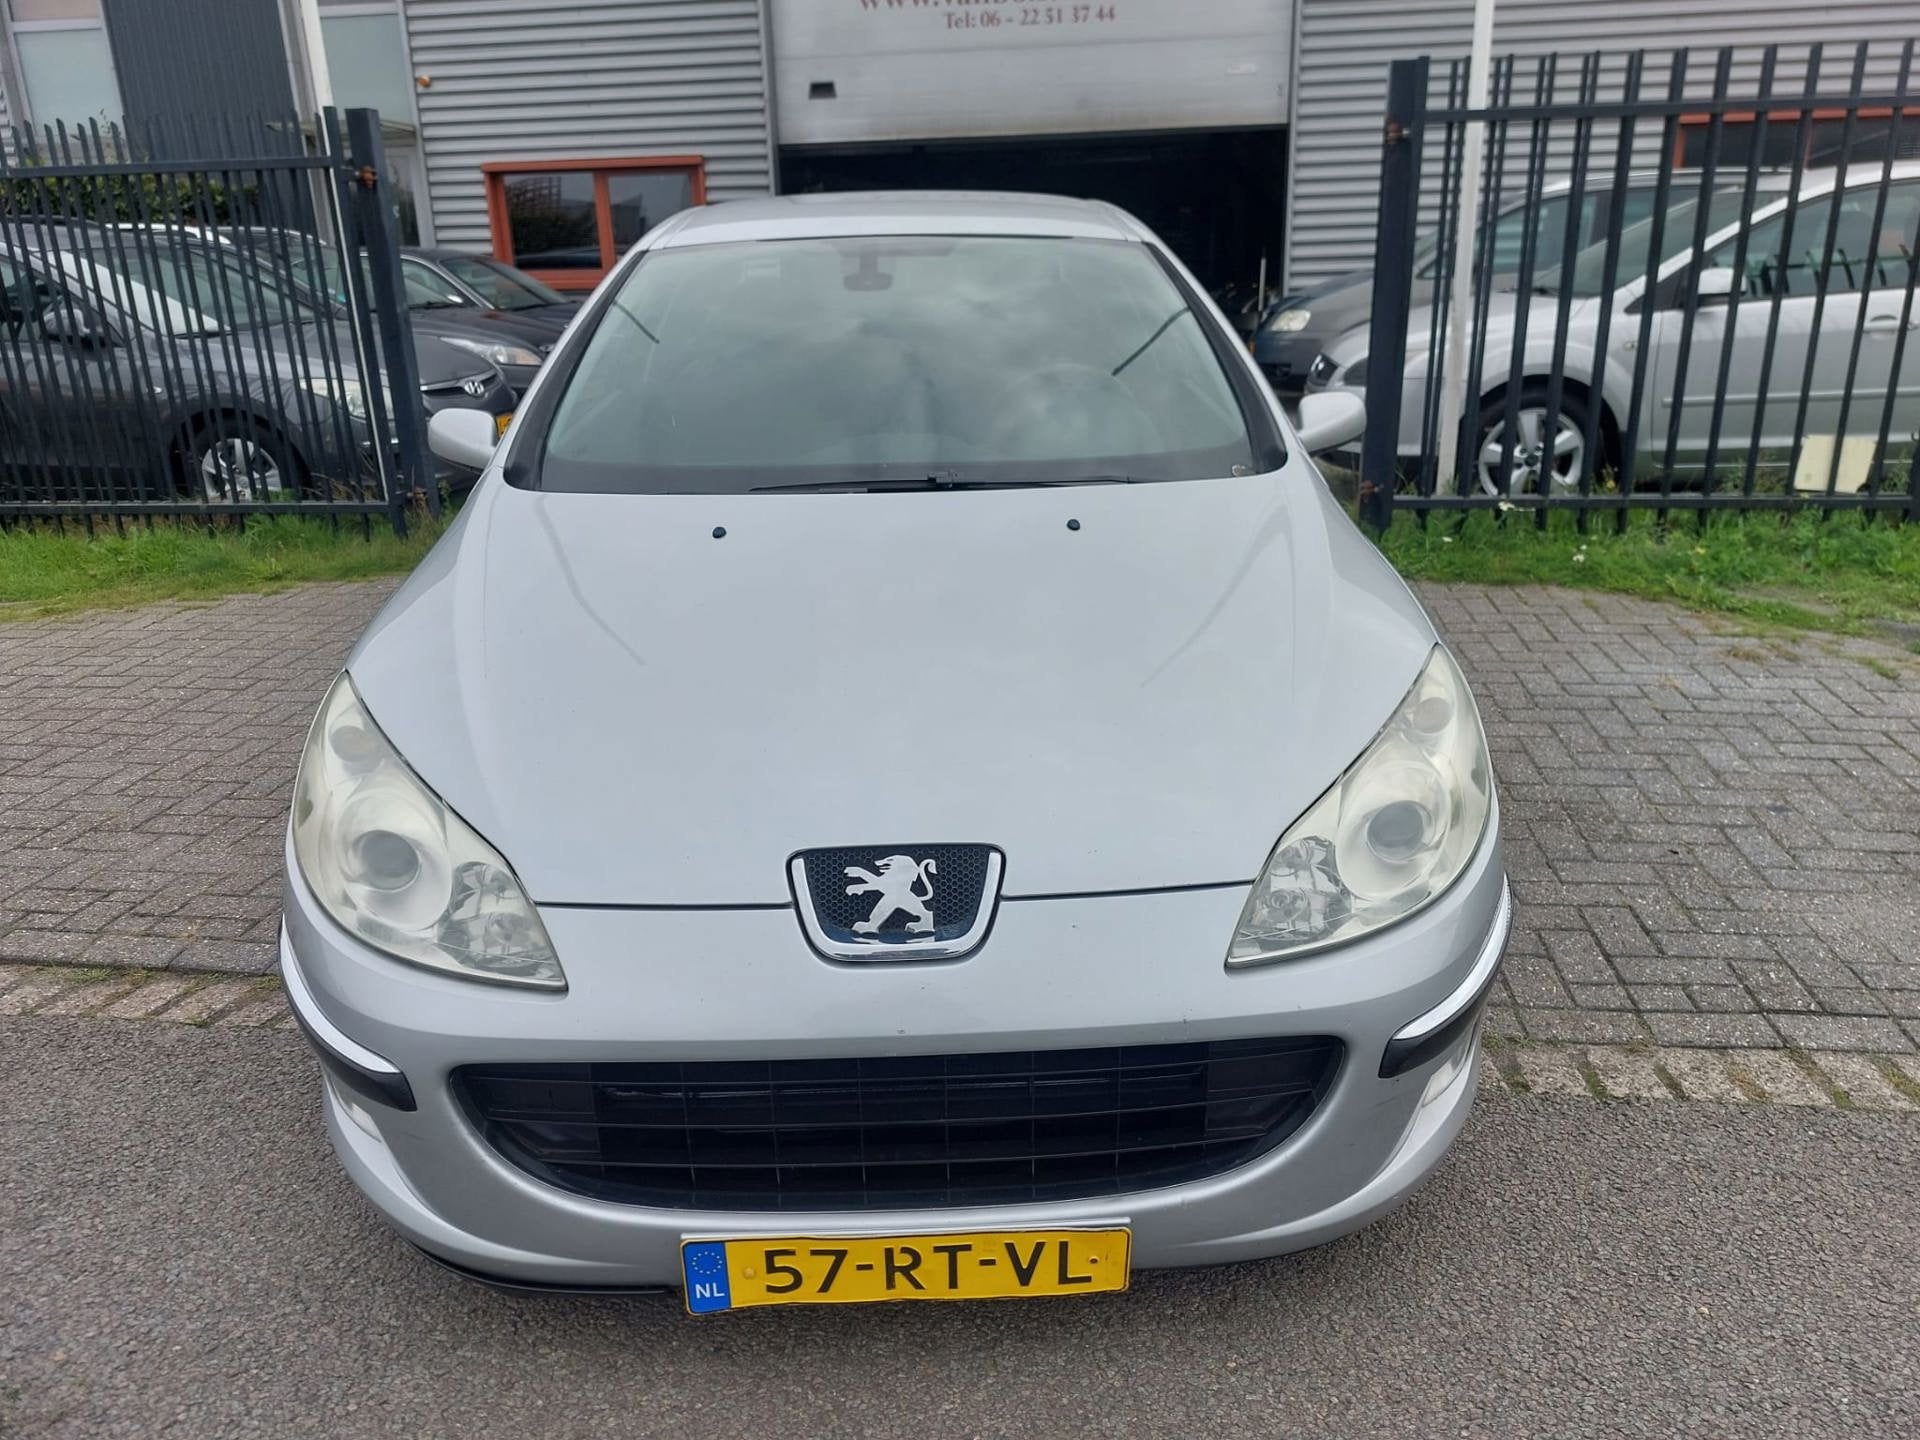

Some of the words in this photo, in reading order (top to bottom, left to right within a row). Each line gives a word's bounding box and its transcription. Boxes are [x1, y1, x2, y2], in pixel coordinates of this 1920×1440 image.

[943, 11, 976, 29] Tel:
[980, 9, 1001, 28] 06
[1019, 8, 1040, 26] 22
[1045, 7, 1063, 25] 51
[1071, 5, 1090, 24] 37
[1096, 4, 1115, 22] 44
[764, 1240, 1093, 1294] 57-RT-VL
[694, 1282, 726, 1299] NL
